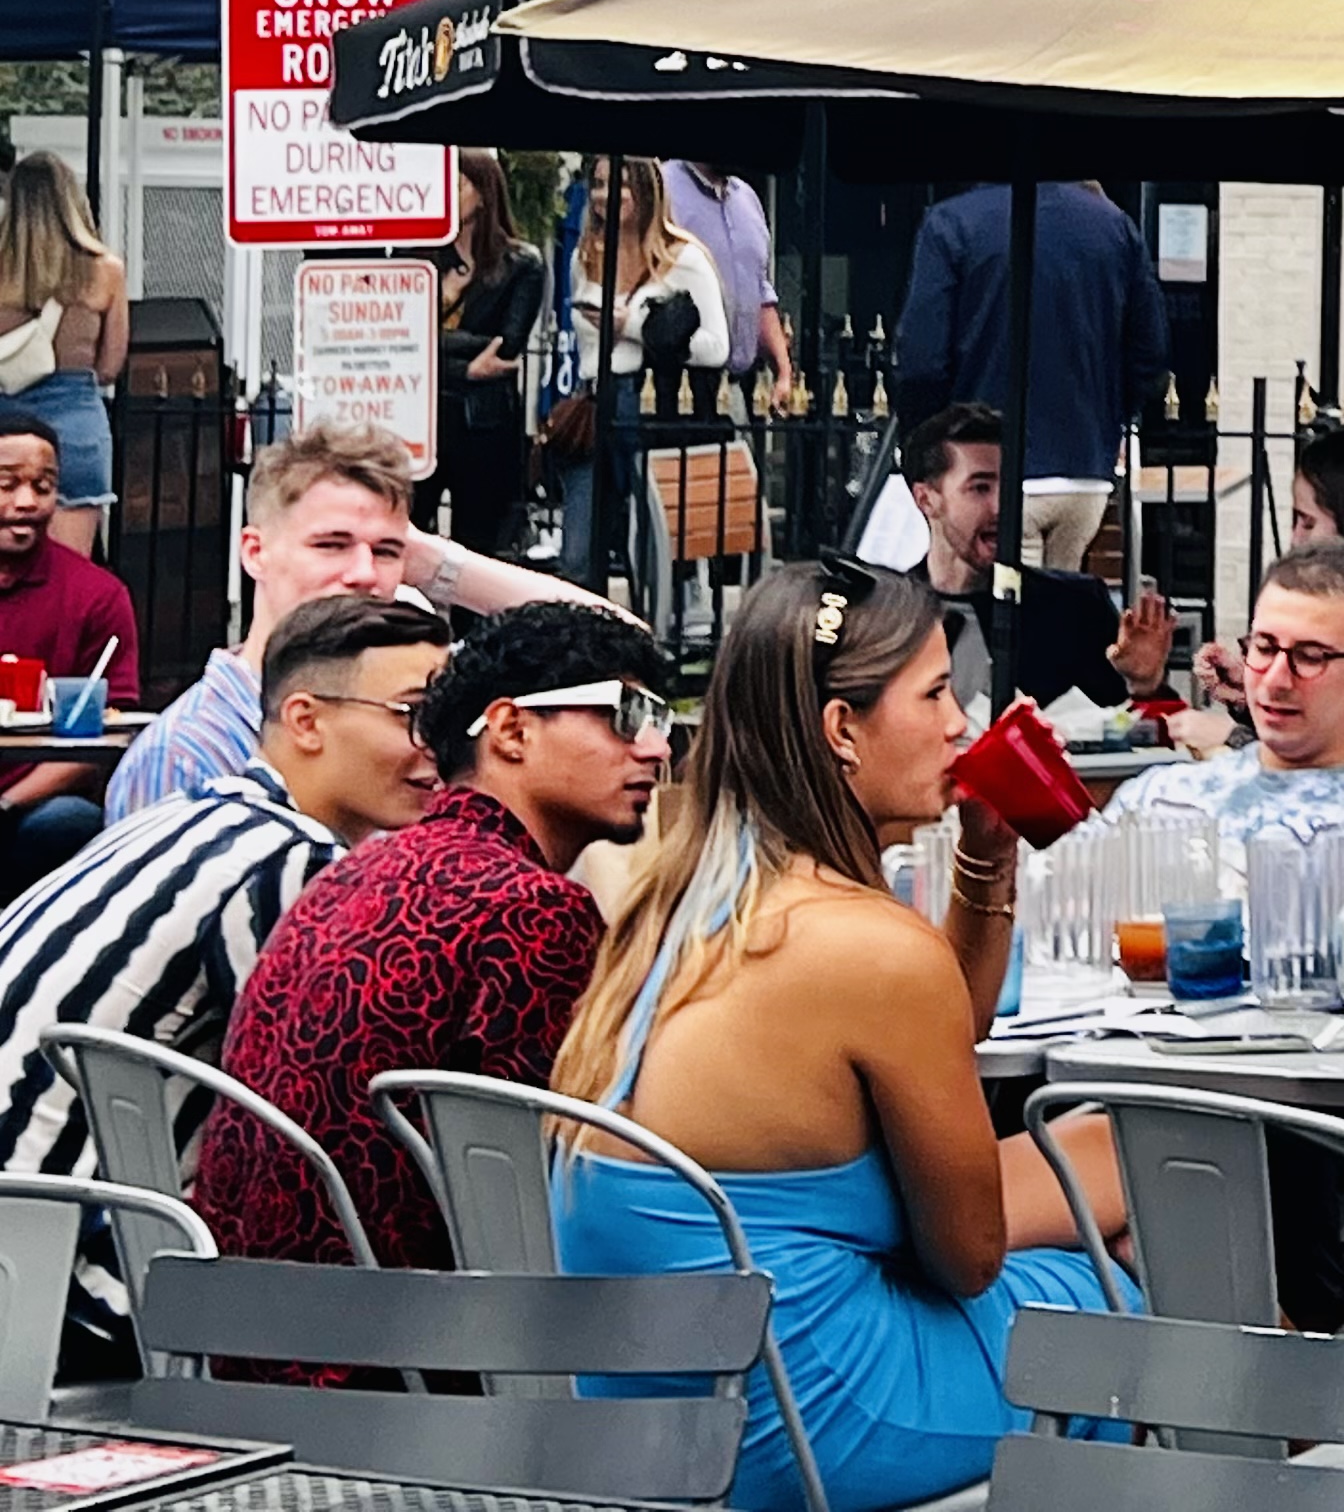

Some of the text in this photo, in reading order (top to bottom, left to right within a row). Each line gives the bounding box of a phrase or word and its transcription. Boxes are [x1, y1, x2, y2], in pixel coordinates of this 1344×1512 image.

[248, 99, 292, 132] NO
[285, 142, 397, 175] DURING
[251, 183, 432, 216] EMERGENCY
[308, 272, 426, 296] NO PARKING
[328, 299, 406, 324] SUNDAY
[336, 399, 394, 421] ZONE
